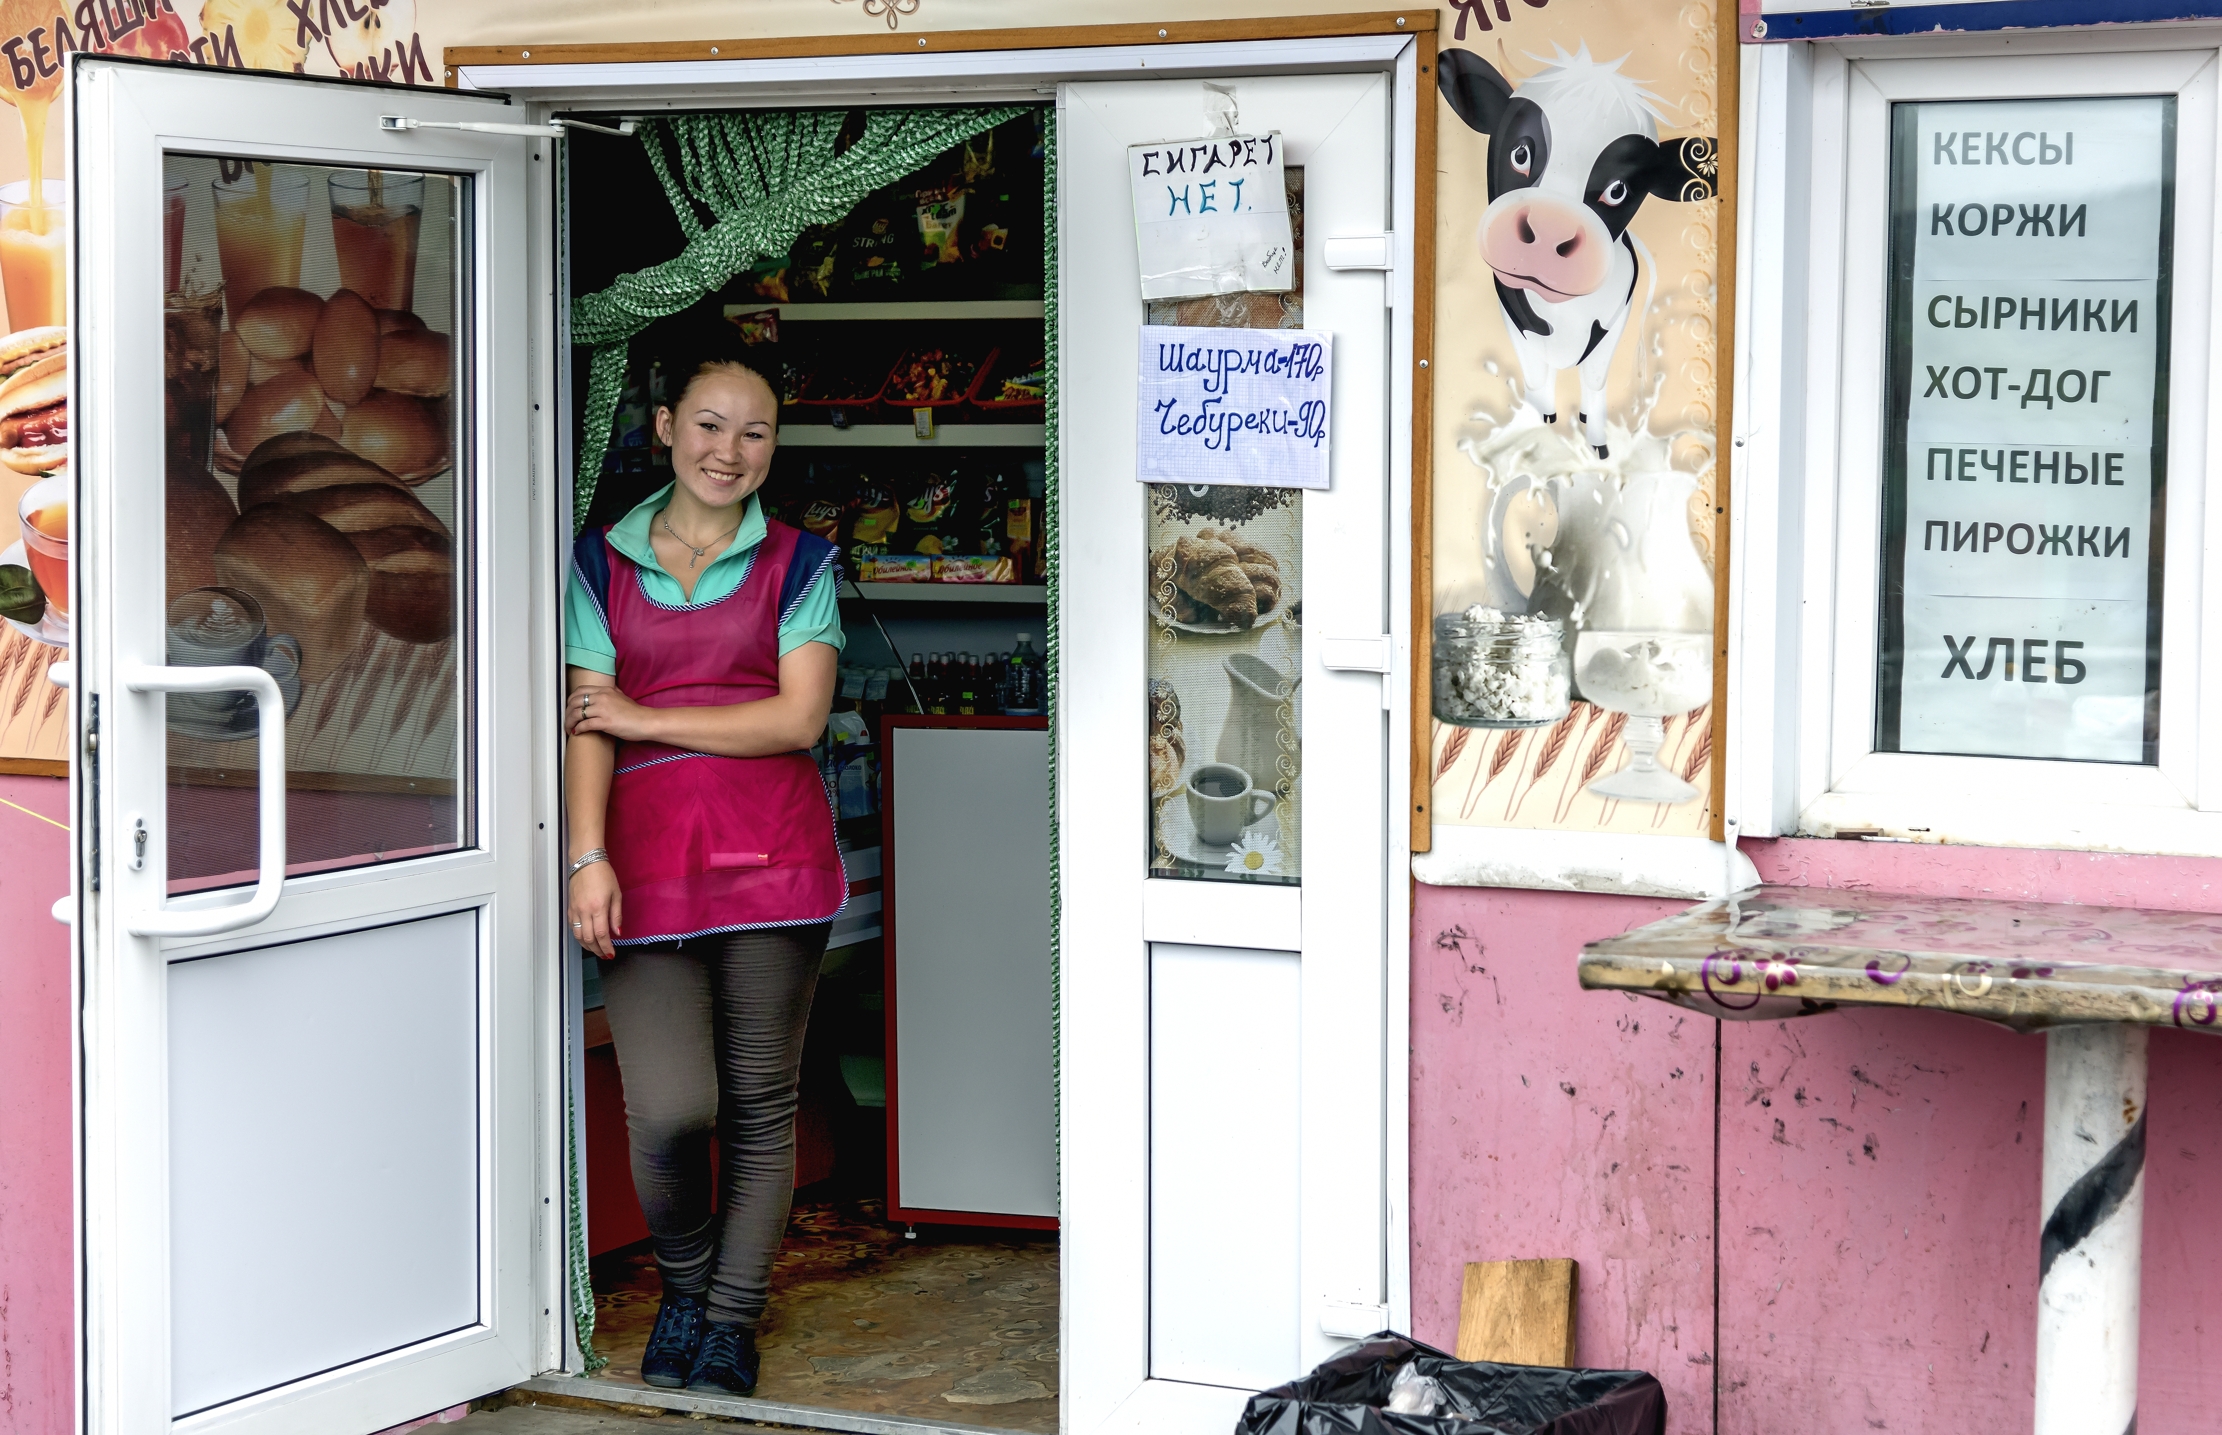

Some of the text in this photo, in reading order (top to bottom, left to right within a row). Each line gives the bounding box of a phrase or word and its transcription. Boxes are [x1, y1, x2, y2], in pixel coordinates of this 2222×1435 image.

[1142, 135, 1274, 176] СИГАРЕТ
[1933, 131, 2074, 165] КЕКСЫ
[1931, 202, 2087, 237] КОРЖИ
[852, 232, 895, 248] STRNG
[1927, 295, 2138, 333] СЫРНИКИ
[1923, 365, 2112, 410] ХОТ-ДОГ
[1927, 447, 2125, 486] ПЕЧЕНЫЕ
[1924, 520, 2131, 558] ПИРОЖКИ
[1940, 634, 2087, 685] ХЛЕБ
